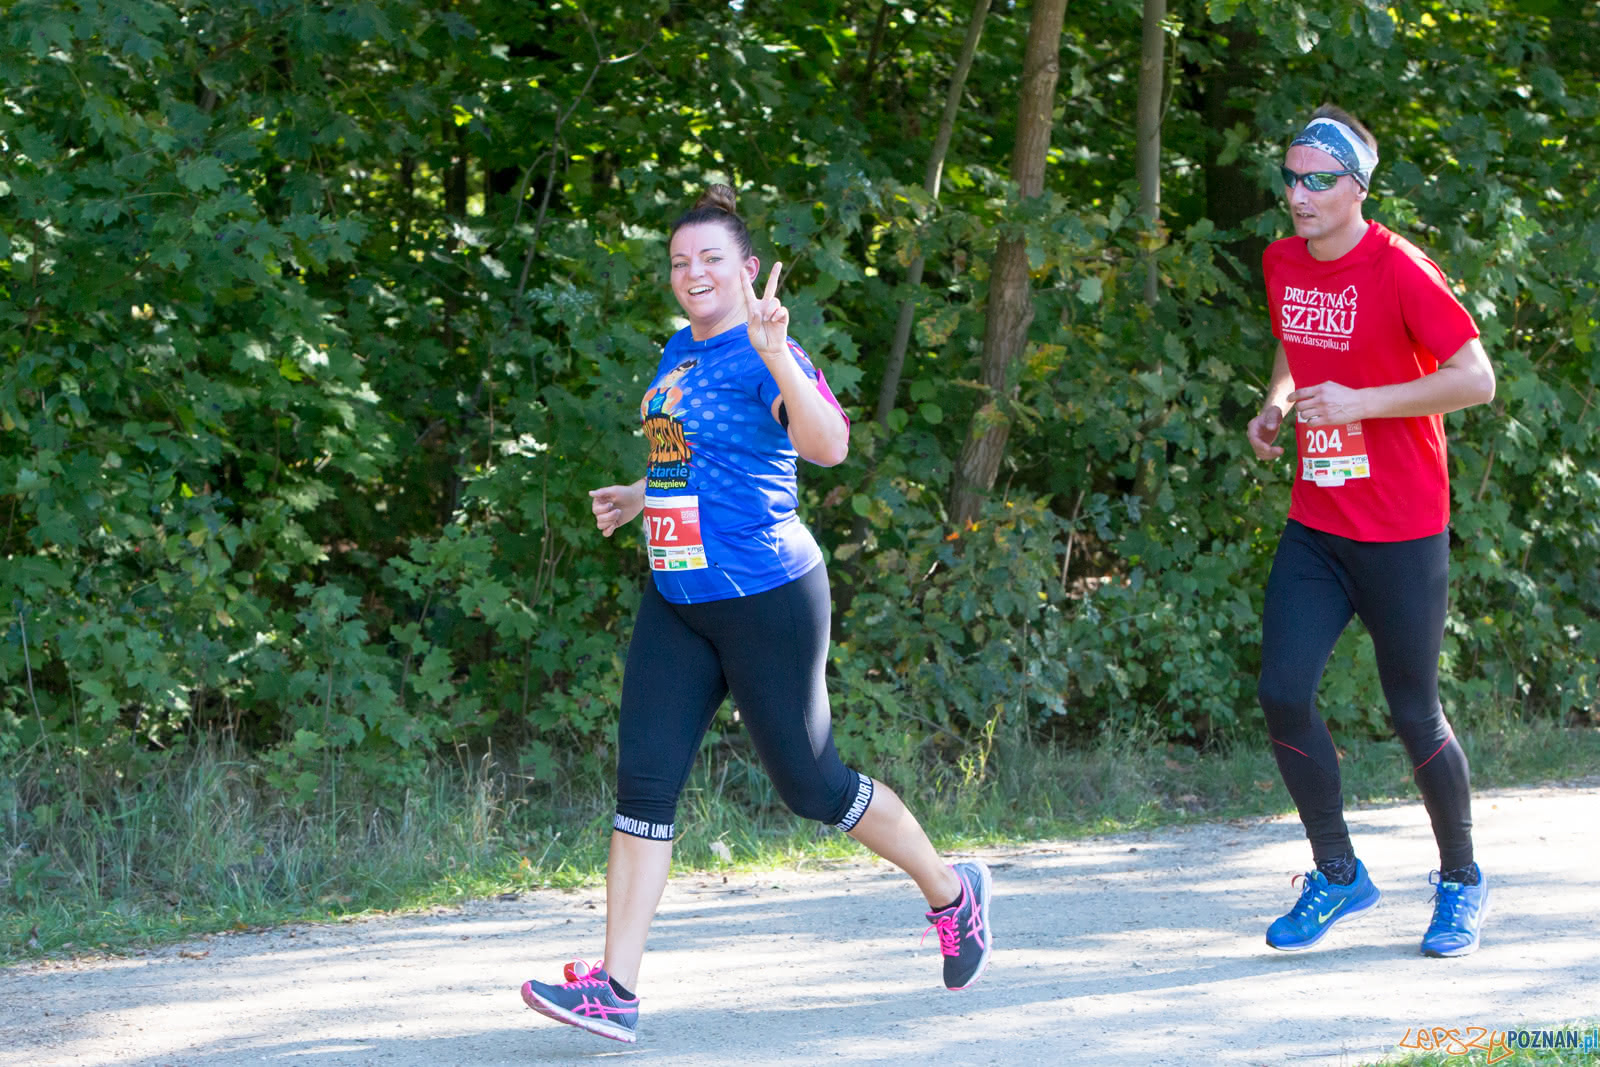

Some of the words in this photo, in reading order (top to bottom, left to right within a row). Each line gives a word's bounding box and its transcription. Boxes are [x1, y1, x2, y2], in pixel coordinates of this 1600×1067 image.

[1284, 286, 1345, 309] DRUŻYNA
[1281, 304, 1357, 334] SZPIKU
[1282, 332, 1350, 352] www.darszpiku.pl
[1306, 428, 1343, 454] 204
[841, 782, 873, 828] ARMOUR
[615, 813, 649, 837] RMOUR
